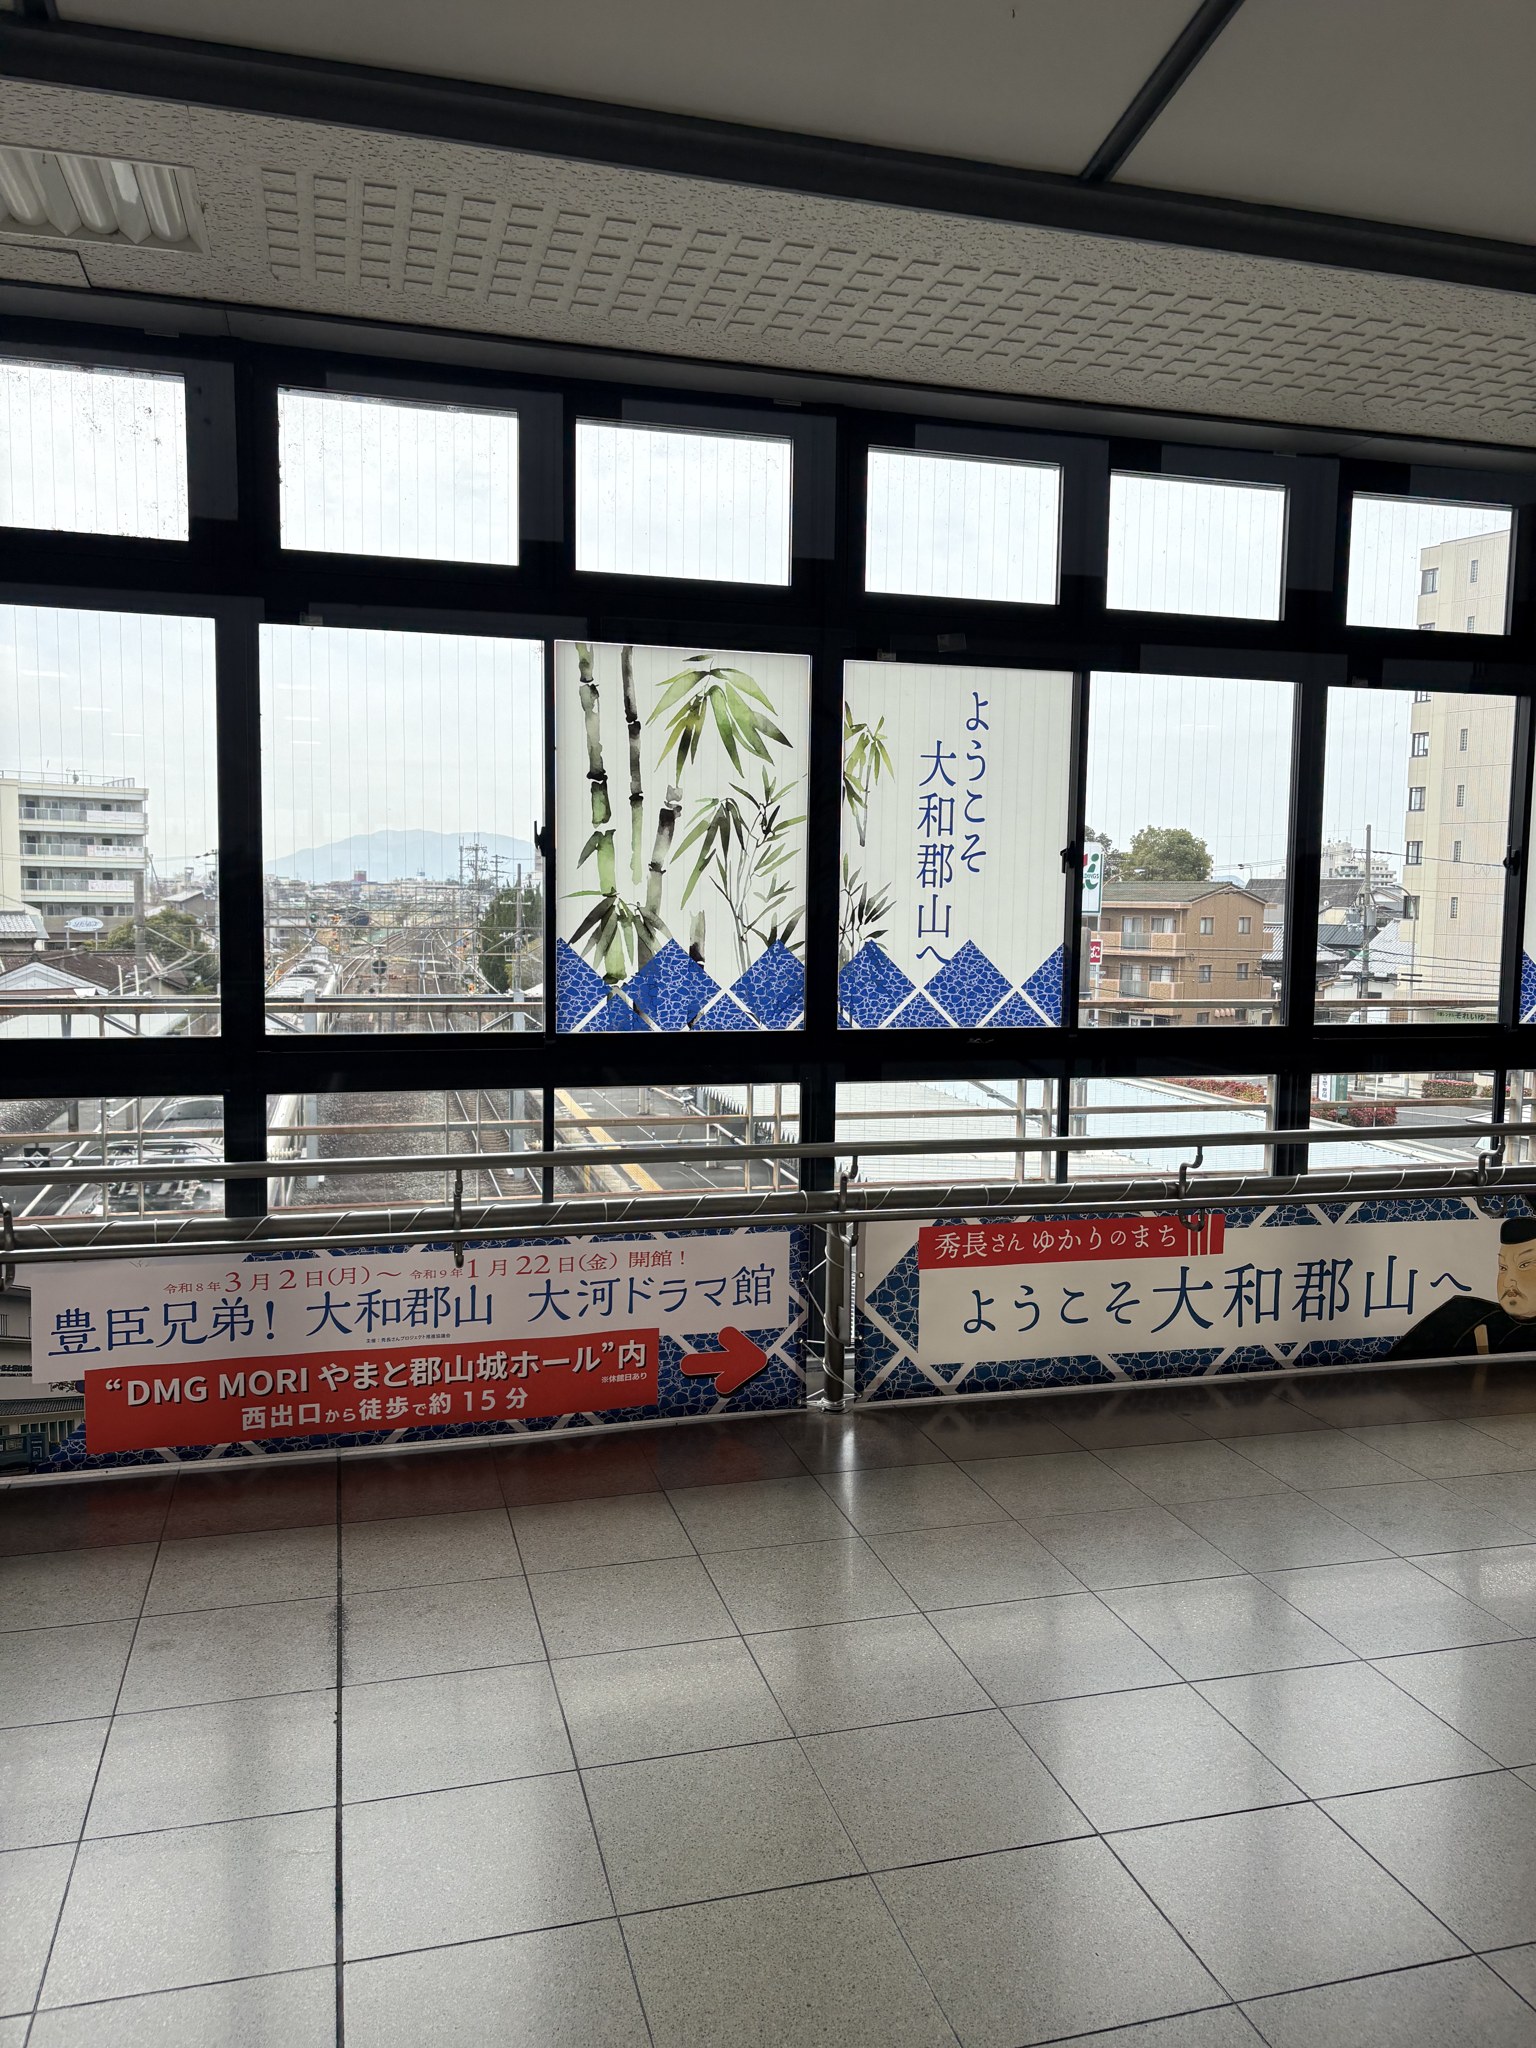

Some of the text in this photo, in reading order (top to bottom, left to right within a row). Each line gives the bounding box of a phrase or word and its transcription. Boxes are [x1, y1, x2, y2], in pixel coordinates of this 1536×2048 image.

[961, 691, 989, 873] ようこそ
[916, 740, 957, 965] 大和郡山へ
[305, 1283, 493, 1337] 大和郡山
[527, 1262, 776, 1324] 大河ドラマ館
[963, 1254, 1473, 1334] ようこそ大和郡山へ
[219, 1366, 309, 1400] MORI
[601, 1372, 648, 1383] ※休館日あり
